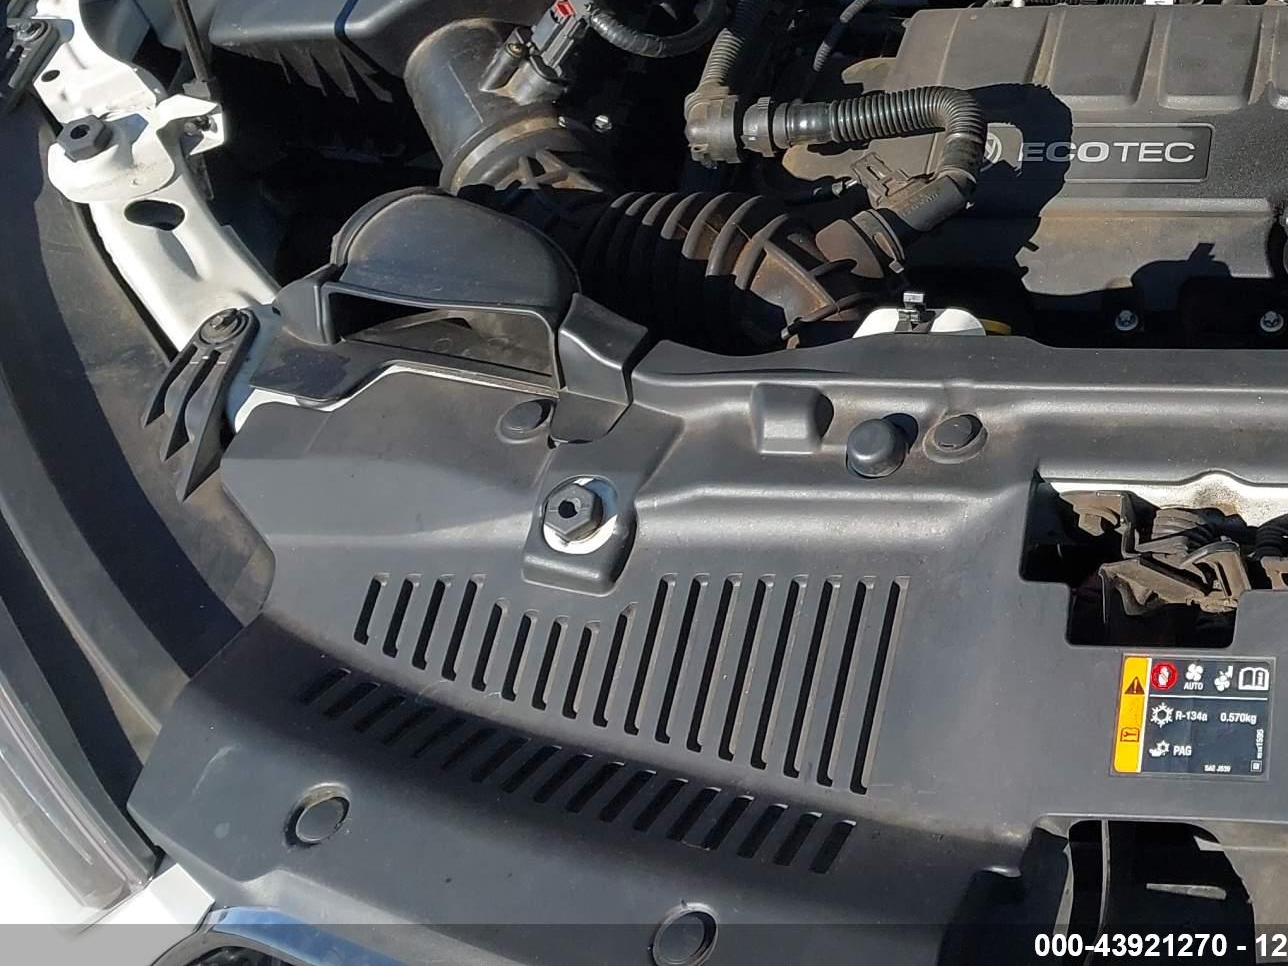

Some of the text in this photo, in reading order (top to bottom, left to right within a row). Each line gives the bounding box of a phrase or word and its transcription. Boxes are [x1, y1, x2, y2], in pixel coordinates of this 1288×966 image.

[1018, 142, 1195, 162] ECOTEC
[1184, 682, 1203, 690] AUTO
[1175, 711, 1257, 725] R-134a 0.570kg
[1173, 746, 1192, 756] PAG
